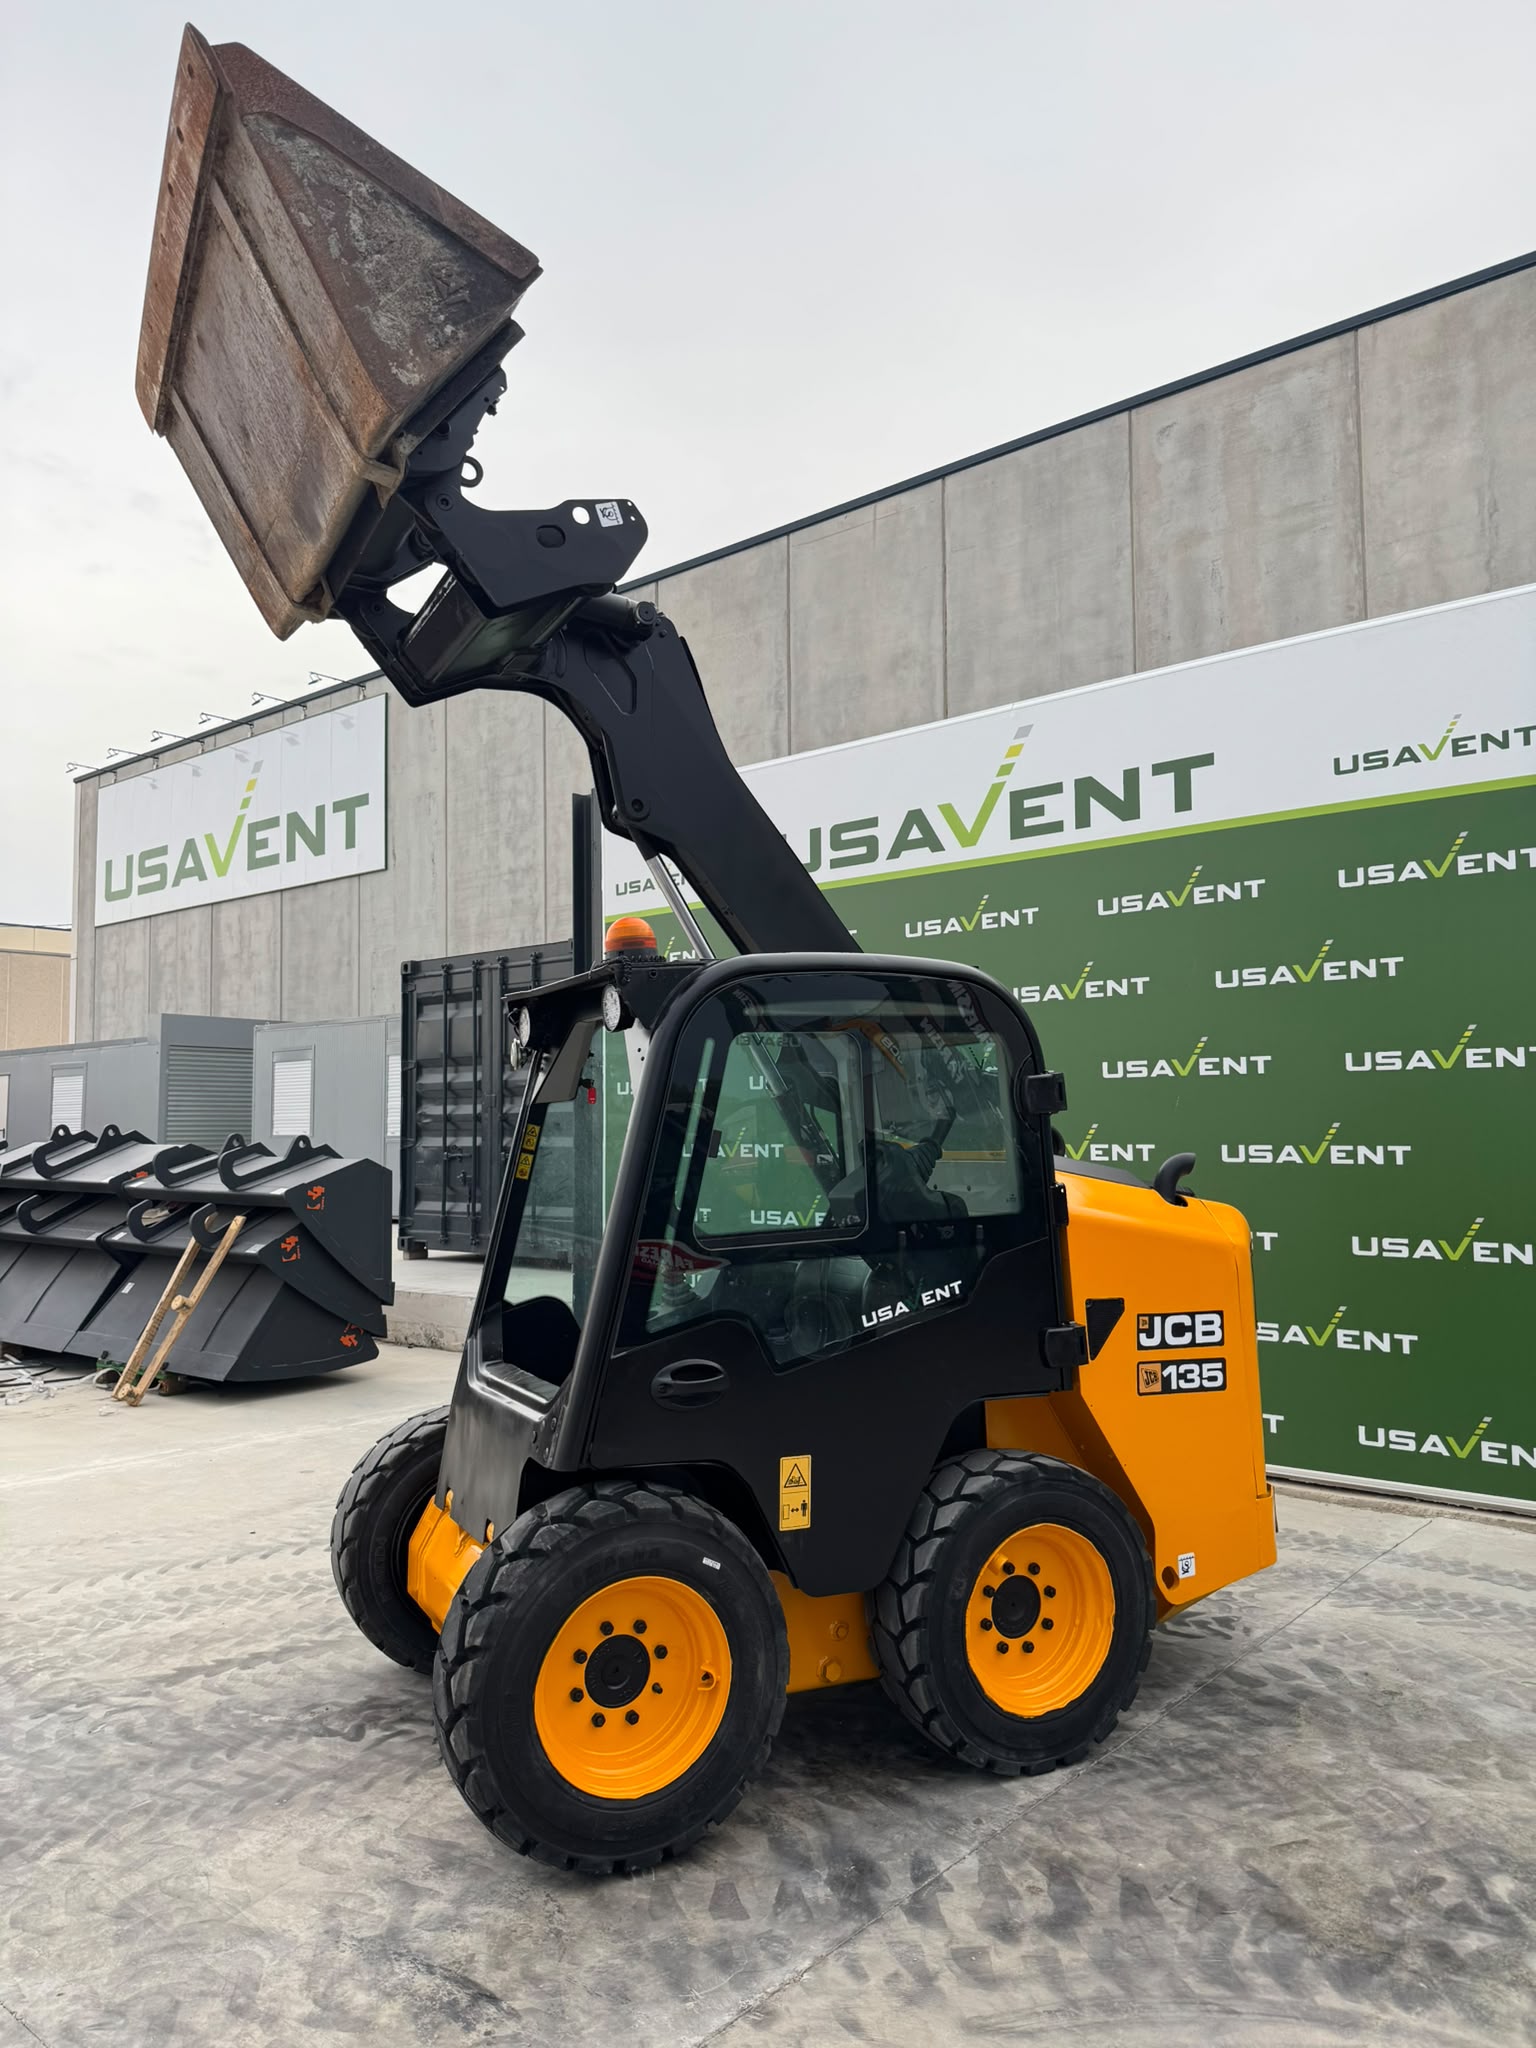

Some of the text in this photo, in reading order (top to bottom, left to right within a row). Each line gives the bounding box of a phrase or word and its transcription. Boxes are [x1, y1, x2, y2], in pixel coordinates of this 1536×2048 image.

[1333, 718, 1536, 775] USAVENT
[104, 775, 370, 902] USAVENT
[1097, 870, 1265, 916] USAVENT
[904, 899, 1039, 939] USAVENT
[1215, 947, 1404, 989] USAVENT
[1102, 1045, 1272, 1079] USAVENT
[1066, 1132, 1155, 1162] VENT
[1221, 1131, 1411, 1166] USAVENT
[1351, 1226, 1534, 1265] USAVEN
[1139, 1313, 1223, 1347] JCB
[1256, 1312, 1418, 1354] SAVENT
[1161, 1362, 1224, 1390] 135
[1358, 1419, 1536, 1468] USAVEN
